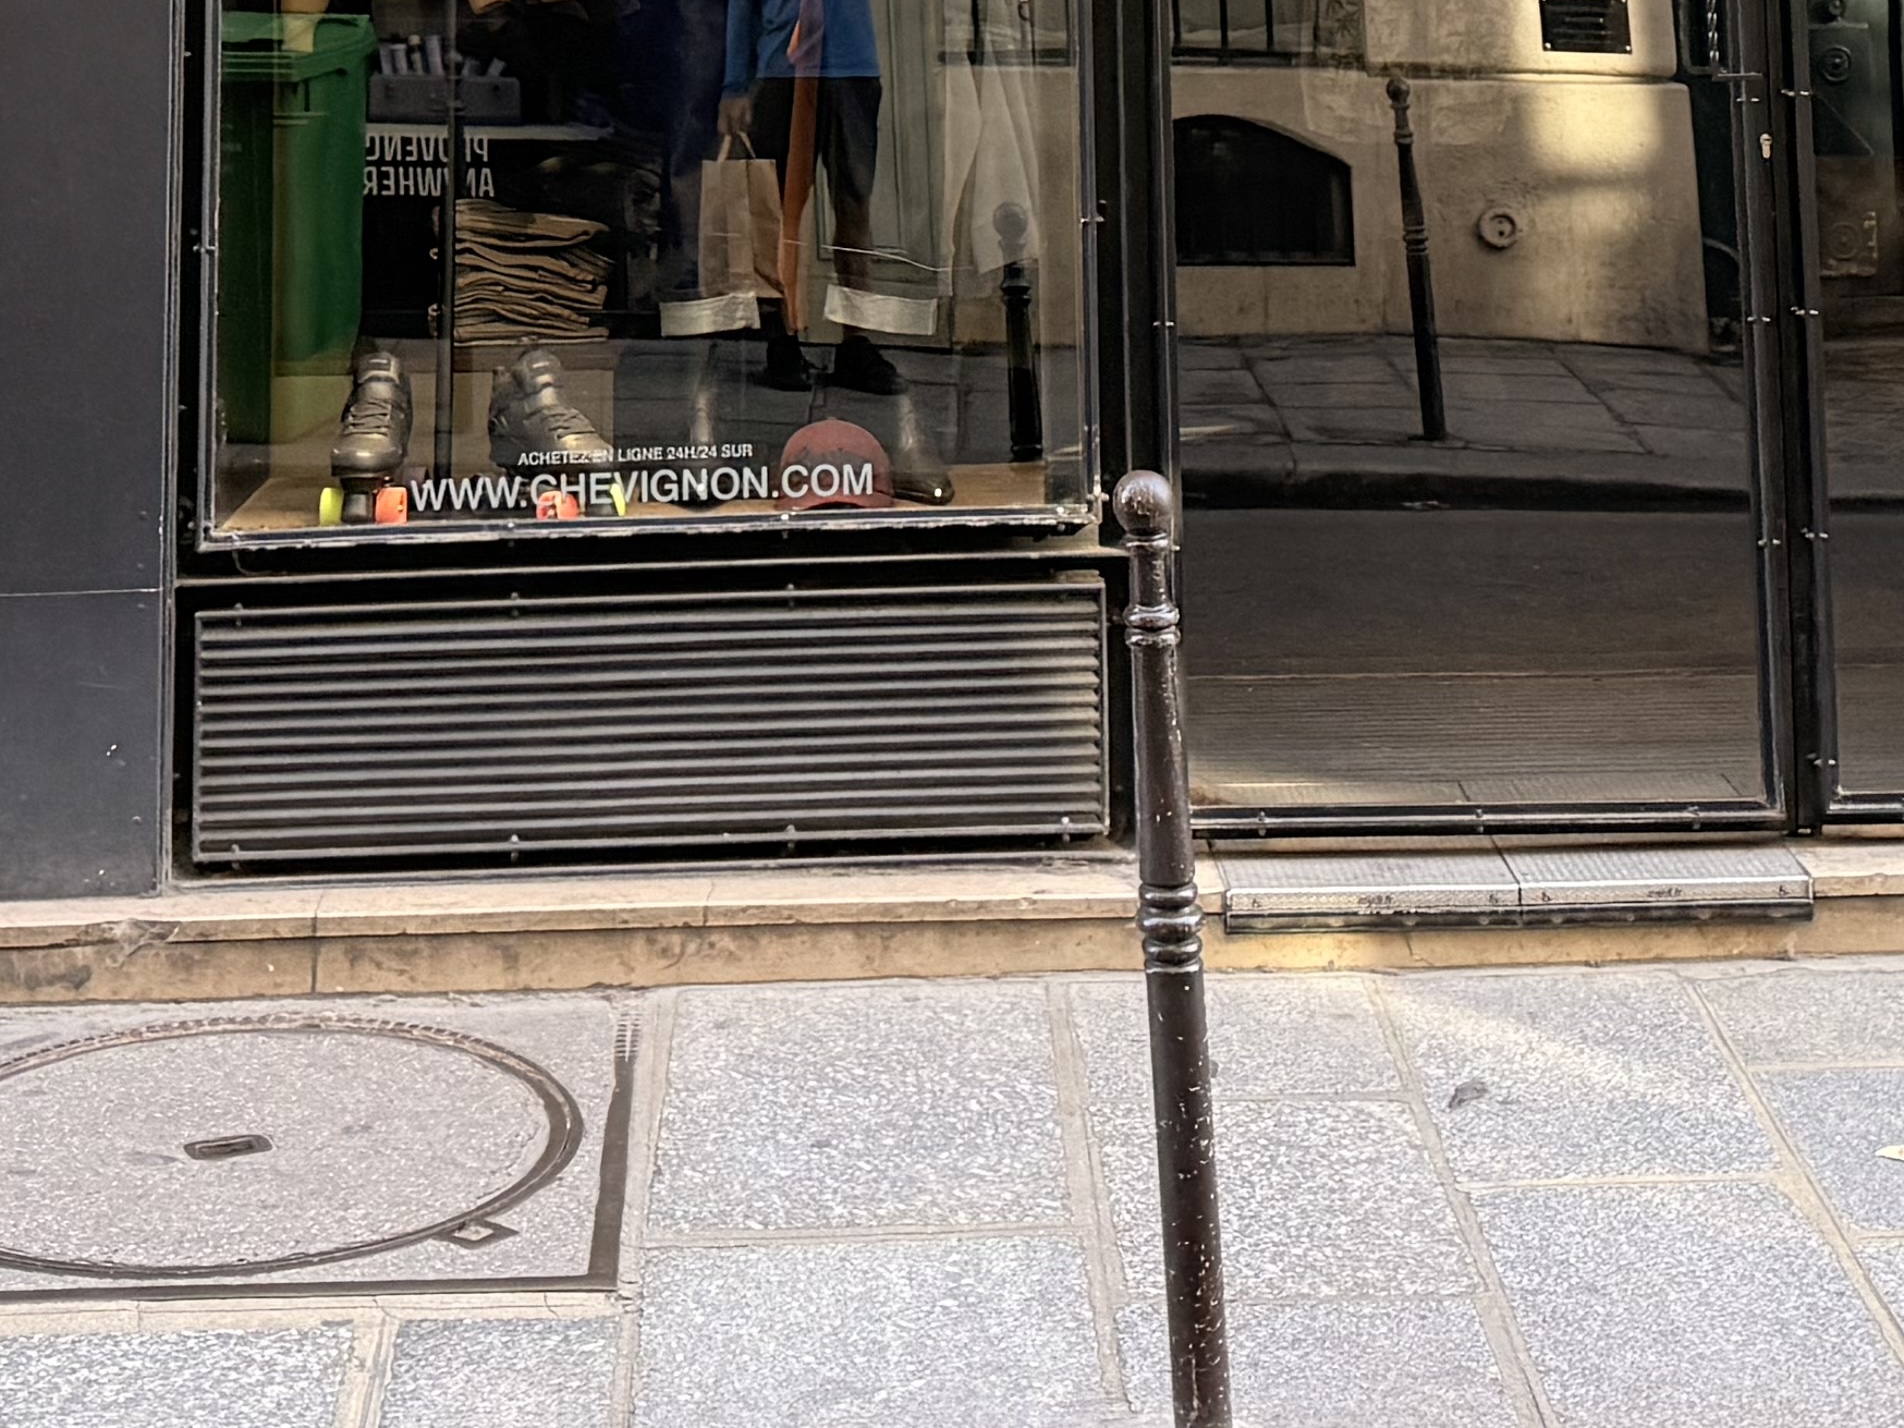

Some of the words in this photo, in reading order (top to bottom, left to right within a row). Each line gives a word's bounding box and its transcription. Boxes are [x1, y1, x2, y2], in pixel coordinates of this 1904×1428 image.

[618, 446, 663, 462] LIGNE
[666, 445, 717, 459] 24H/24
[721, 444, 753, 458] SUR
[410, 462, 873, 512] WWW.CHEVIGNON.COM
